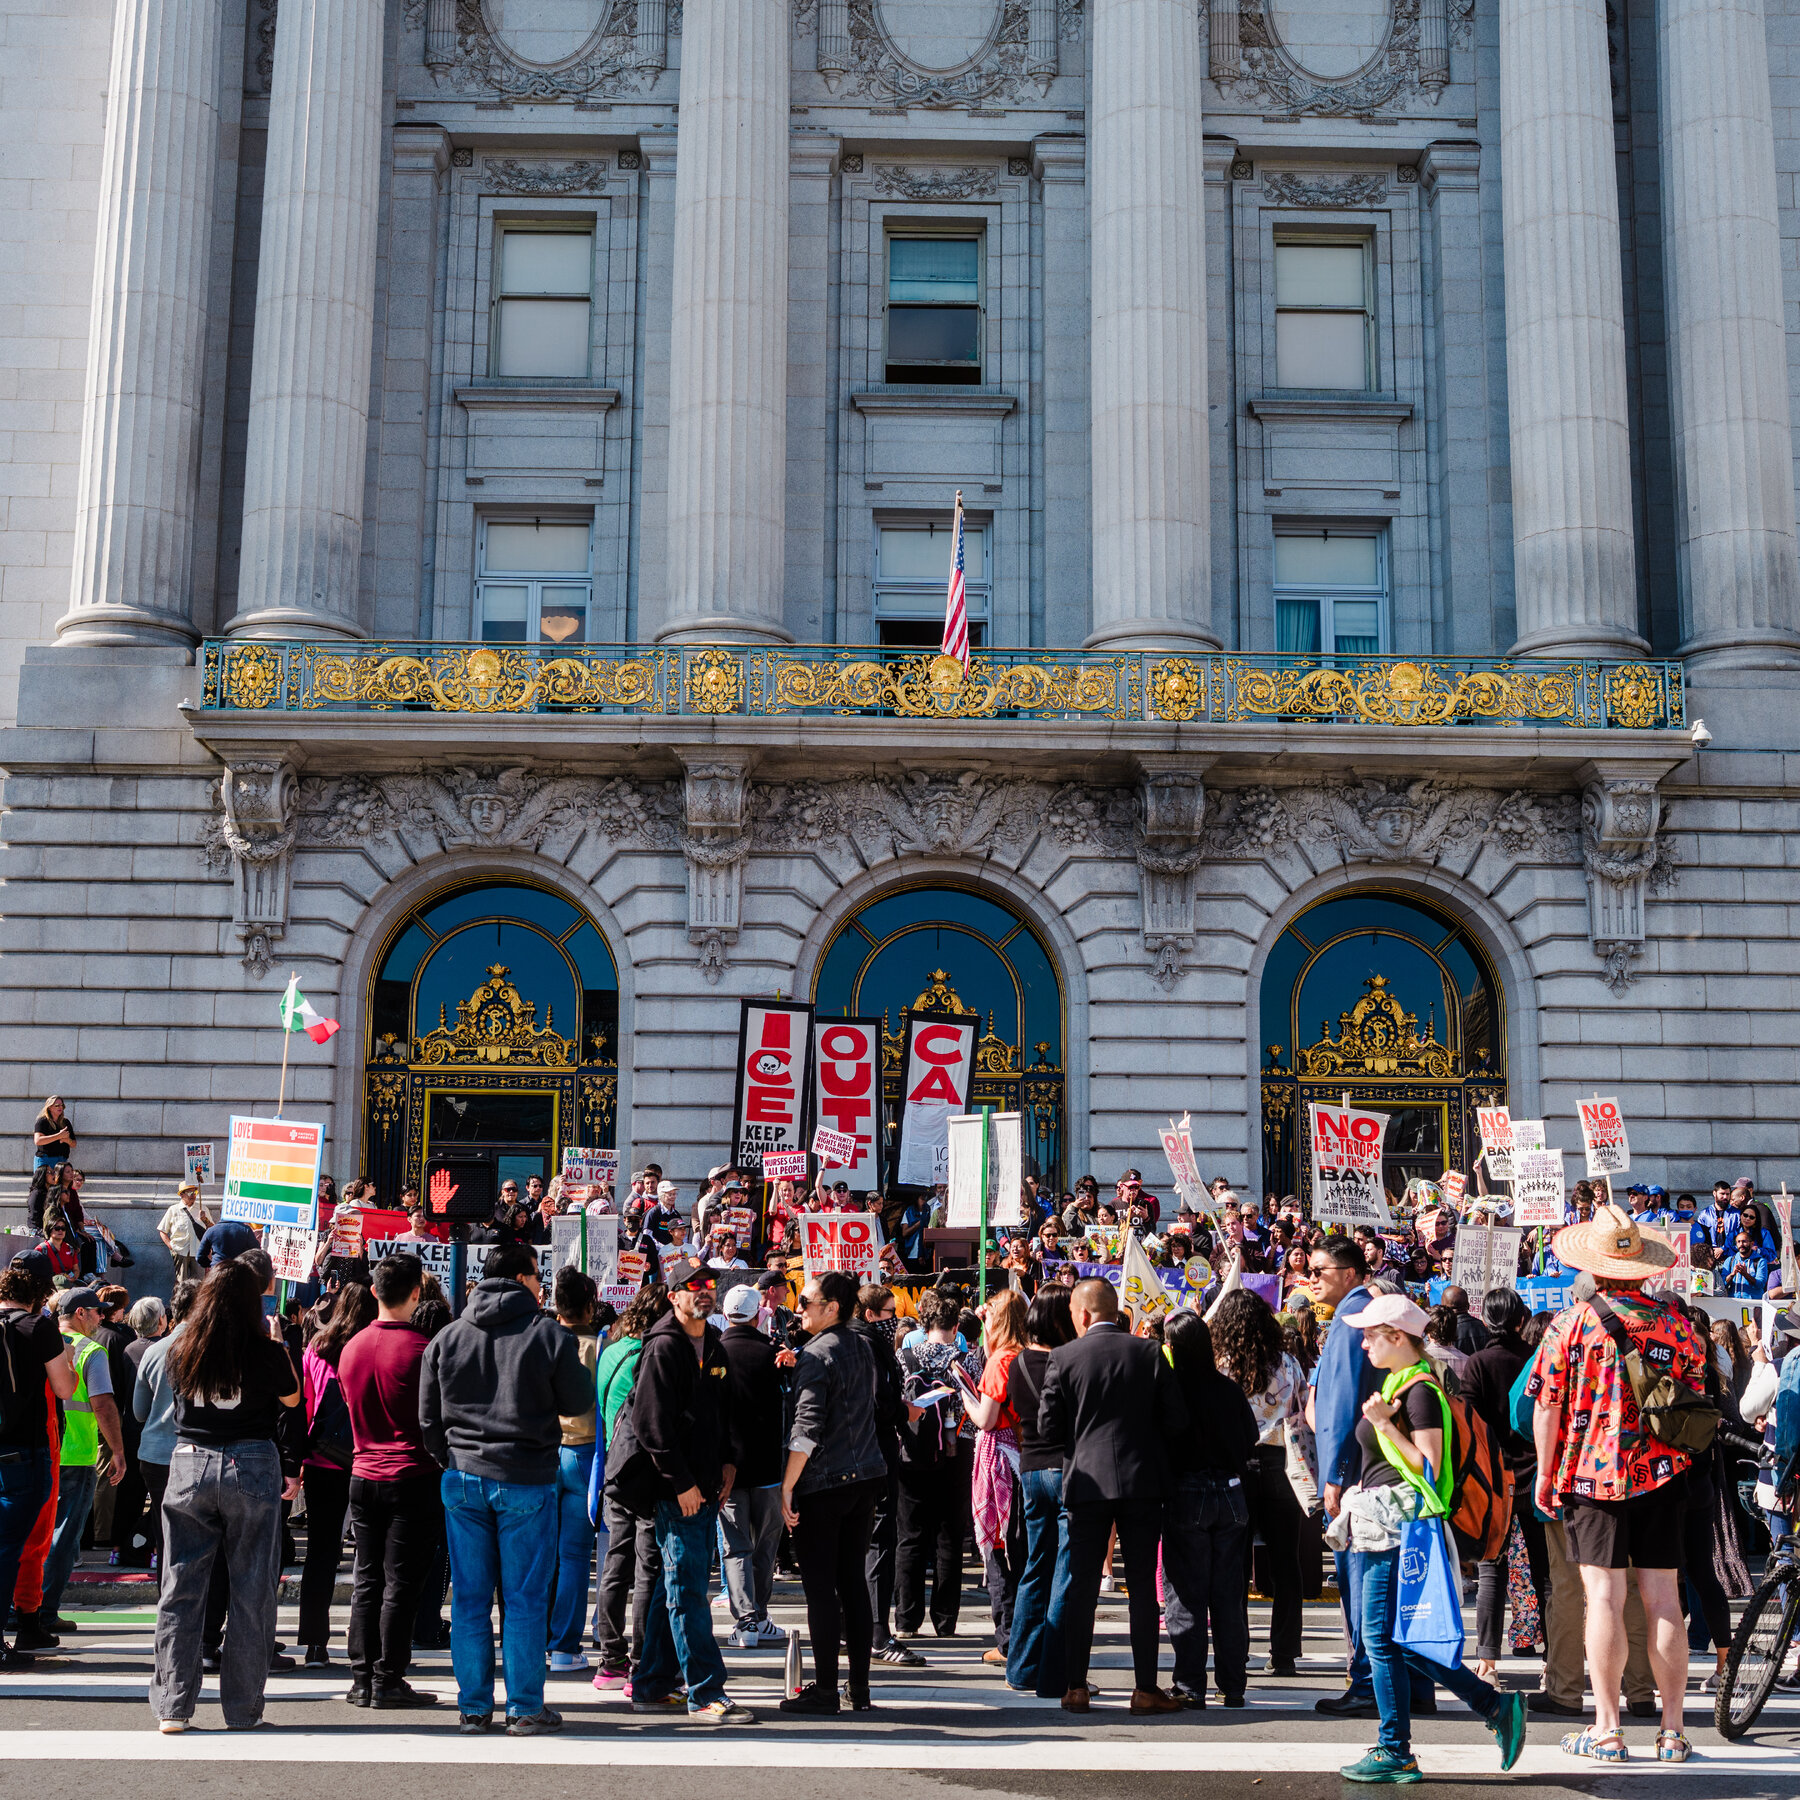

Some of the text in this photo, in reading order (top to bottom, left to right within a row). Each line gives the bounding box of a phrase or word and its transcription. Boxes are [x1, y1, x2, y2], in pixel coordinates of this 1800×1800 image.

[746, 1012, 795, 1124] ICE
[820, 1026, 872, 1133] OUT
[1582, 1103, 1617, 1120] NO
[1317, 1112, 1380, 1142] NO
[1480, 1112, 1509, 1128] NO
[234, 1122, 251, 1139] LOVE
[745, 1125, 787, 1142] KEEP
[818, 1130, 830, 1138] OUR
[187, 1145, 211, 1156] MELT
[232, 1141, 247, 1158] THY
[740, 1141, 795, 1154] FAMILIES
[815, 1142, 851, 1158] NO BORDERS
[817, 1136, 853, 1151] RIGHTS HAVE
[1315, 1136, 1332, 1152] ICE
[1339, 1138, 1380, 1160] TROOPS
[1588, 1137, 1624, 1149] BAY!
[567, 1148, 614, 1159] WE STAND
[764, 1155, 805, 1167] NURSES CARE
[1336, 1155, 1344, 1166] IN
[230, 1160, 268, 1180] NEIGHBOR
[565, 1167, 615, 1182] NO ICE
[768, 1164, 806, 1176] ALL PEOPLE
[1320, 1165, 1378, 1188] BAY!
[228, 1180, 239, 1196] NO
[225, 1199, 274, 1220] EXCEPTIONS
[807, 1221, 871, 1244] NO
[416, 1243, 451, 1262] KEE
[806, 1244, 824, 1259] ICE
[830, 1243, 874, 1259] TROOPS
[827, 1259, 835, 1270] IN
[606, 1286, 636, 1296] POWER
[1649, 1346, 1671, 1362] 415
[1575, 1481, 1591, 1495] 415
